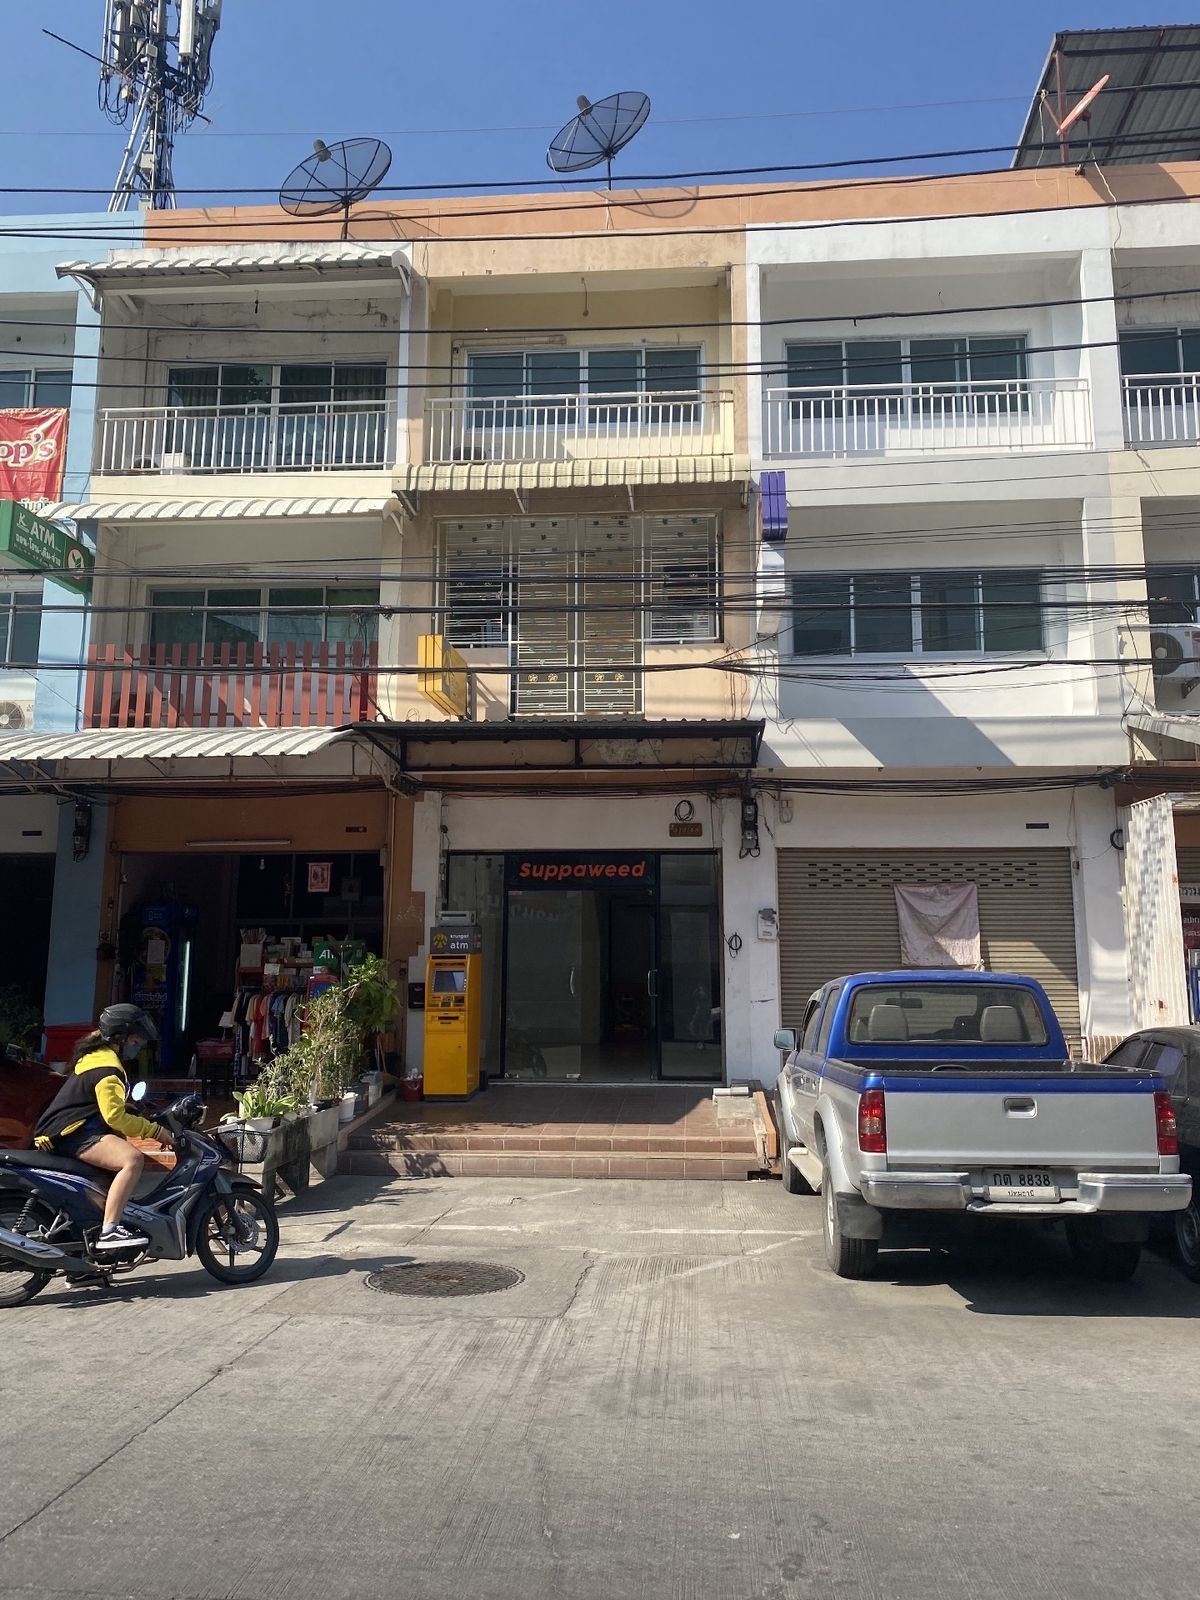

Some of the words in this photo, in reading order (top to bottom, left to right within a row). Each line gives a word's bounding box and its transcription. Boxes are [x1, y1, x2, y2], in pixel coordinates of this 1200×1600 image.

[30, 521, 55, 549] ATM
[450, 941, 469, 949] atm
[1018, 1174, 1051, 1186] 8838
